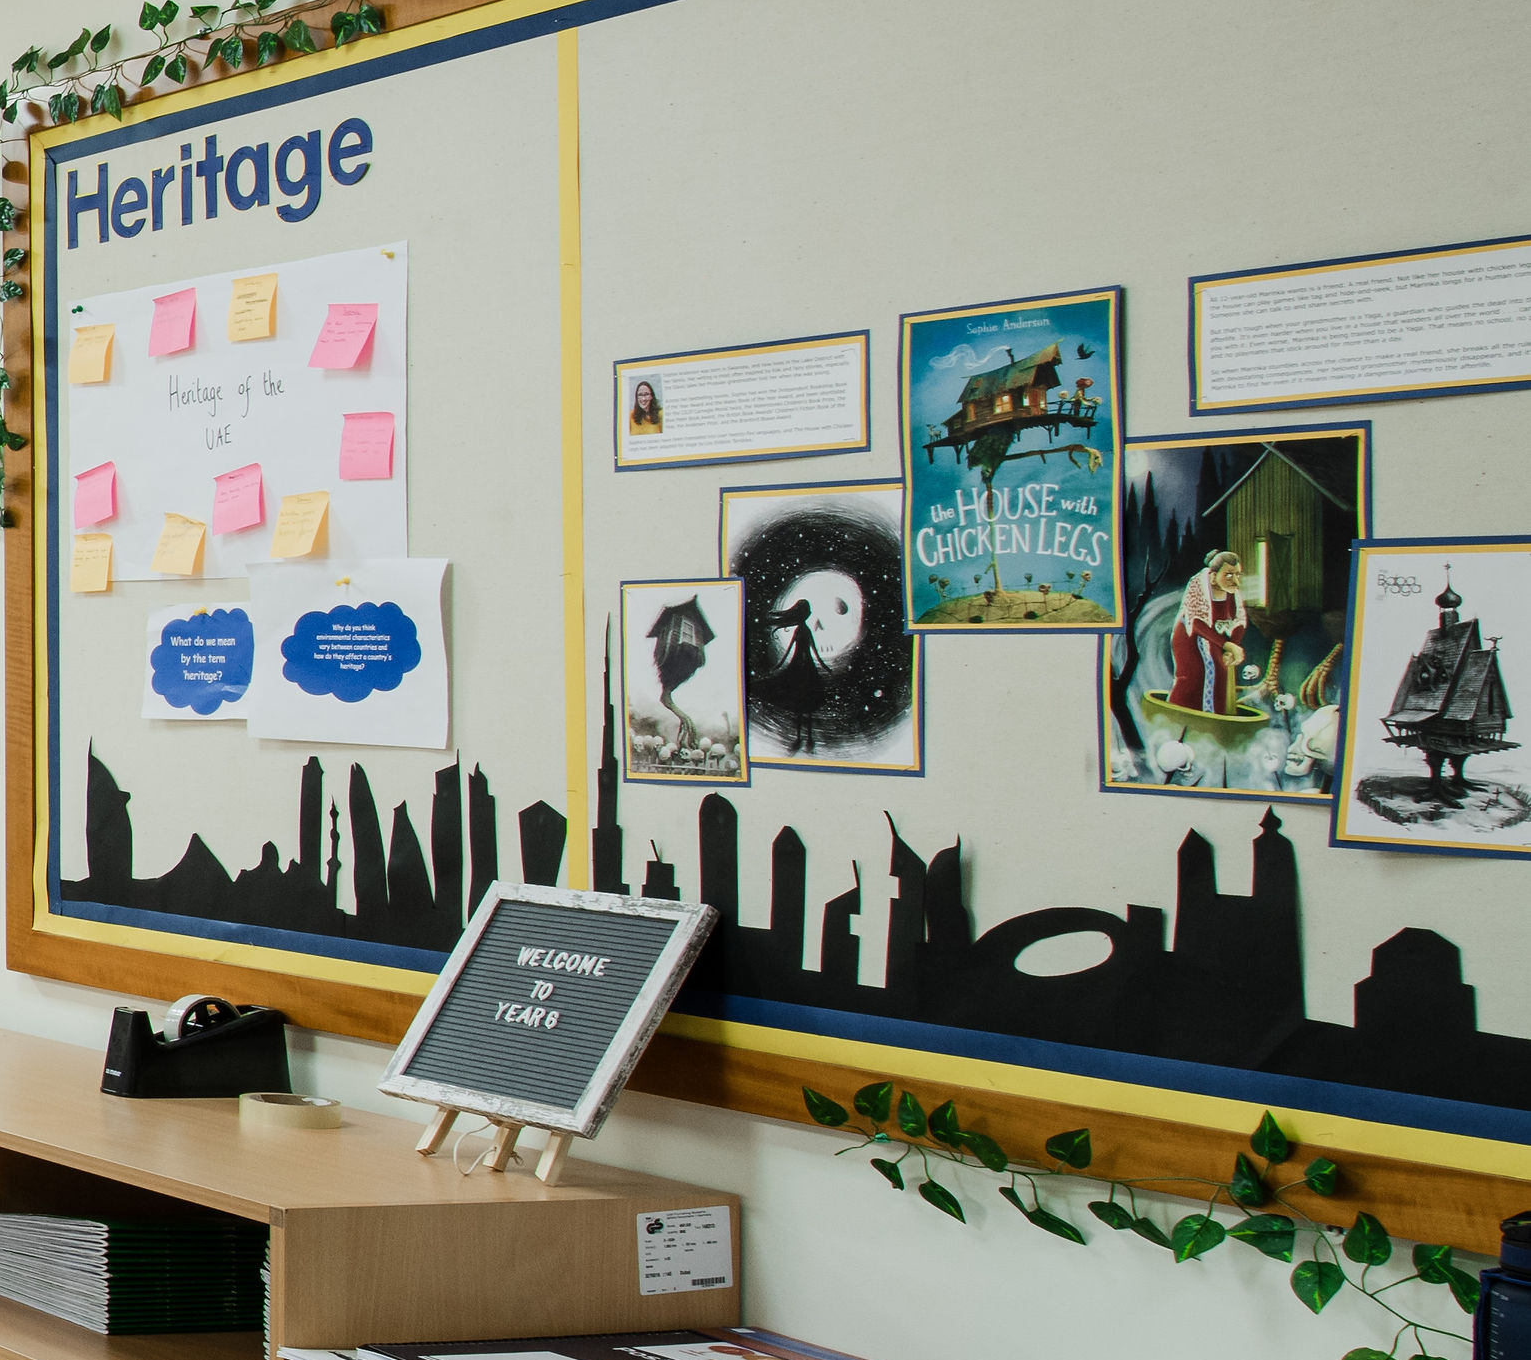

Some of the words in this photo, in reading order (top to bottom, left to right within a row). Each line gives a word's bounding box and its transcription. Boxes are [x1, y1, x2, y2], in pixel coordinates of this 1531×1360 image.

[67, 117, 374, 250] Heritage
[967, 323, 998, 335] Sophie
[1003, 317, 1050, 330] Anderson
[168, 374, 223, 418] Heritage
[238, 380, 255, 418] of
[263, 369, 285, 398] the
[205, 425, 232, 451] UAE
[931, 505, 954, 523] the
[955, 483, 1059, 526] HOUSE
[1061, 497, 1097, 516] with
[917, 524, 1030, 567] CHICKEN
[1037, 518, 1108, 567] LEGS
[171, 637, 191, 646] What
[194, 637, 204, 646] do
[331, 643, 352, 651] between
[181, 654, 190, 664] by
[193, 654, 206, 663] the
[208, 654, 225, 663] term
[333, 653, 344, 661] they
[340, 662, 364, 671] heritage?
[517, 945, 612, 978] WELCOME
[530, 980, 553, 1001] TO
[495, 1002, 541, 1029] YEAR
